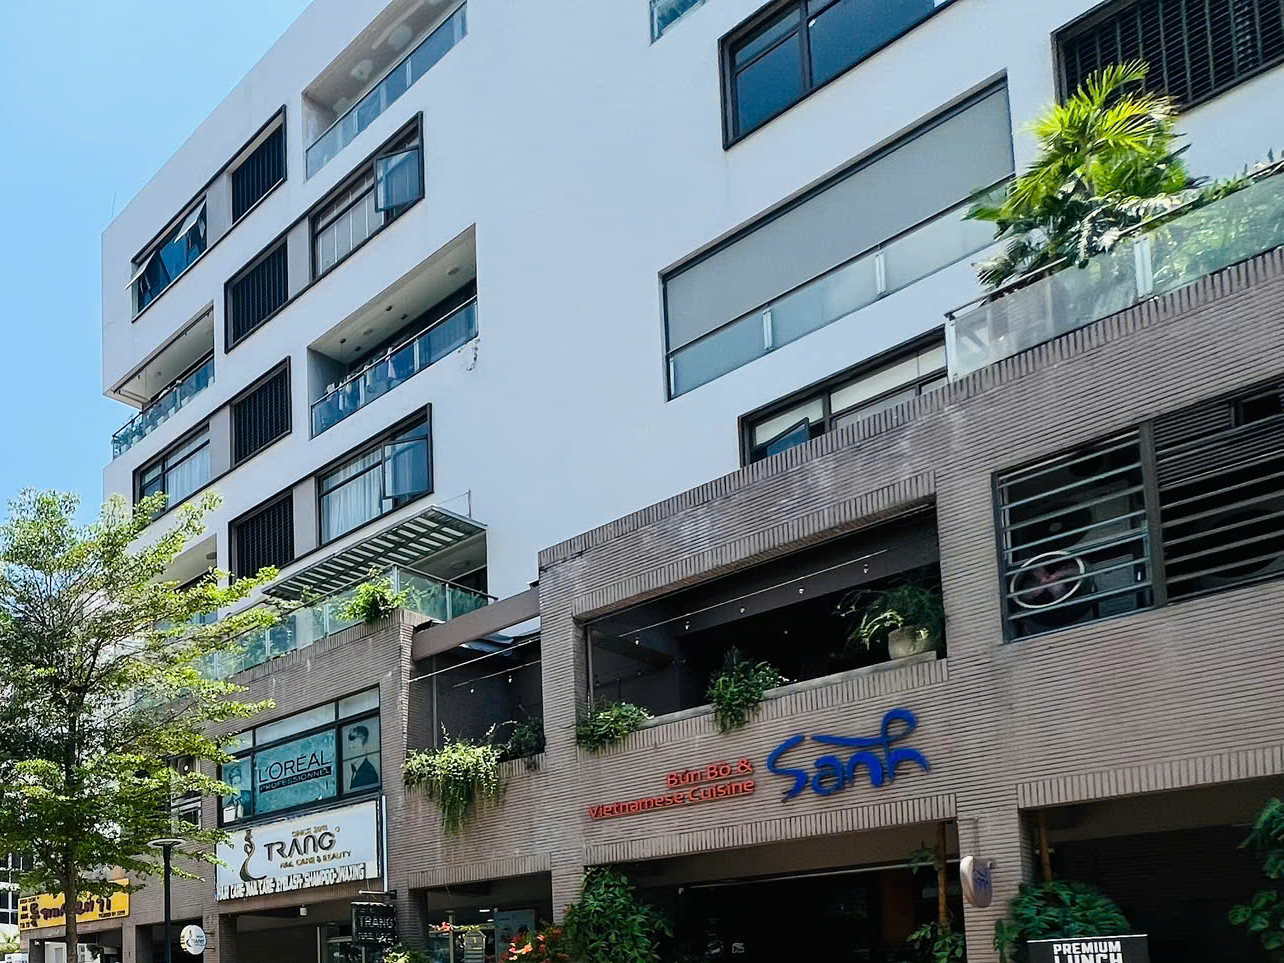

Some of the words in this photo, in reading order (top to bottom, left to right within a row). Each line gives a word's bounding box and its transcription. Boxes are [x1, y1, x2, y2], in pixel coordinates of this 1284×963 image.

[258, 750, 332, 783] L'ORÉAL
[260, 766, 331, 792] PROFESSIONNEL
[666, 769, 701, 787] Bún
[737, 757, 754, 774] &
[588, 791, 684, 819] Vietnamese
[688, 779, 756, 801] Cuisine
[1053, 941, 1121, 955] PREMIUM
